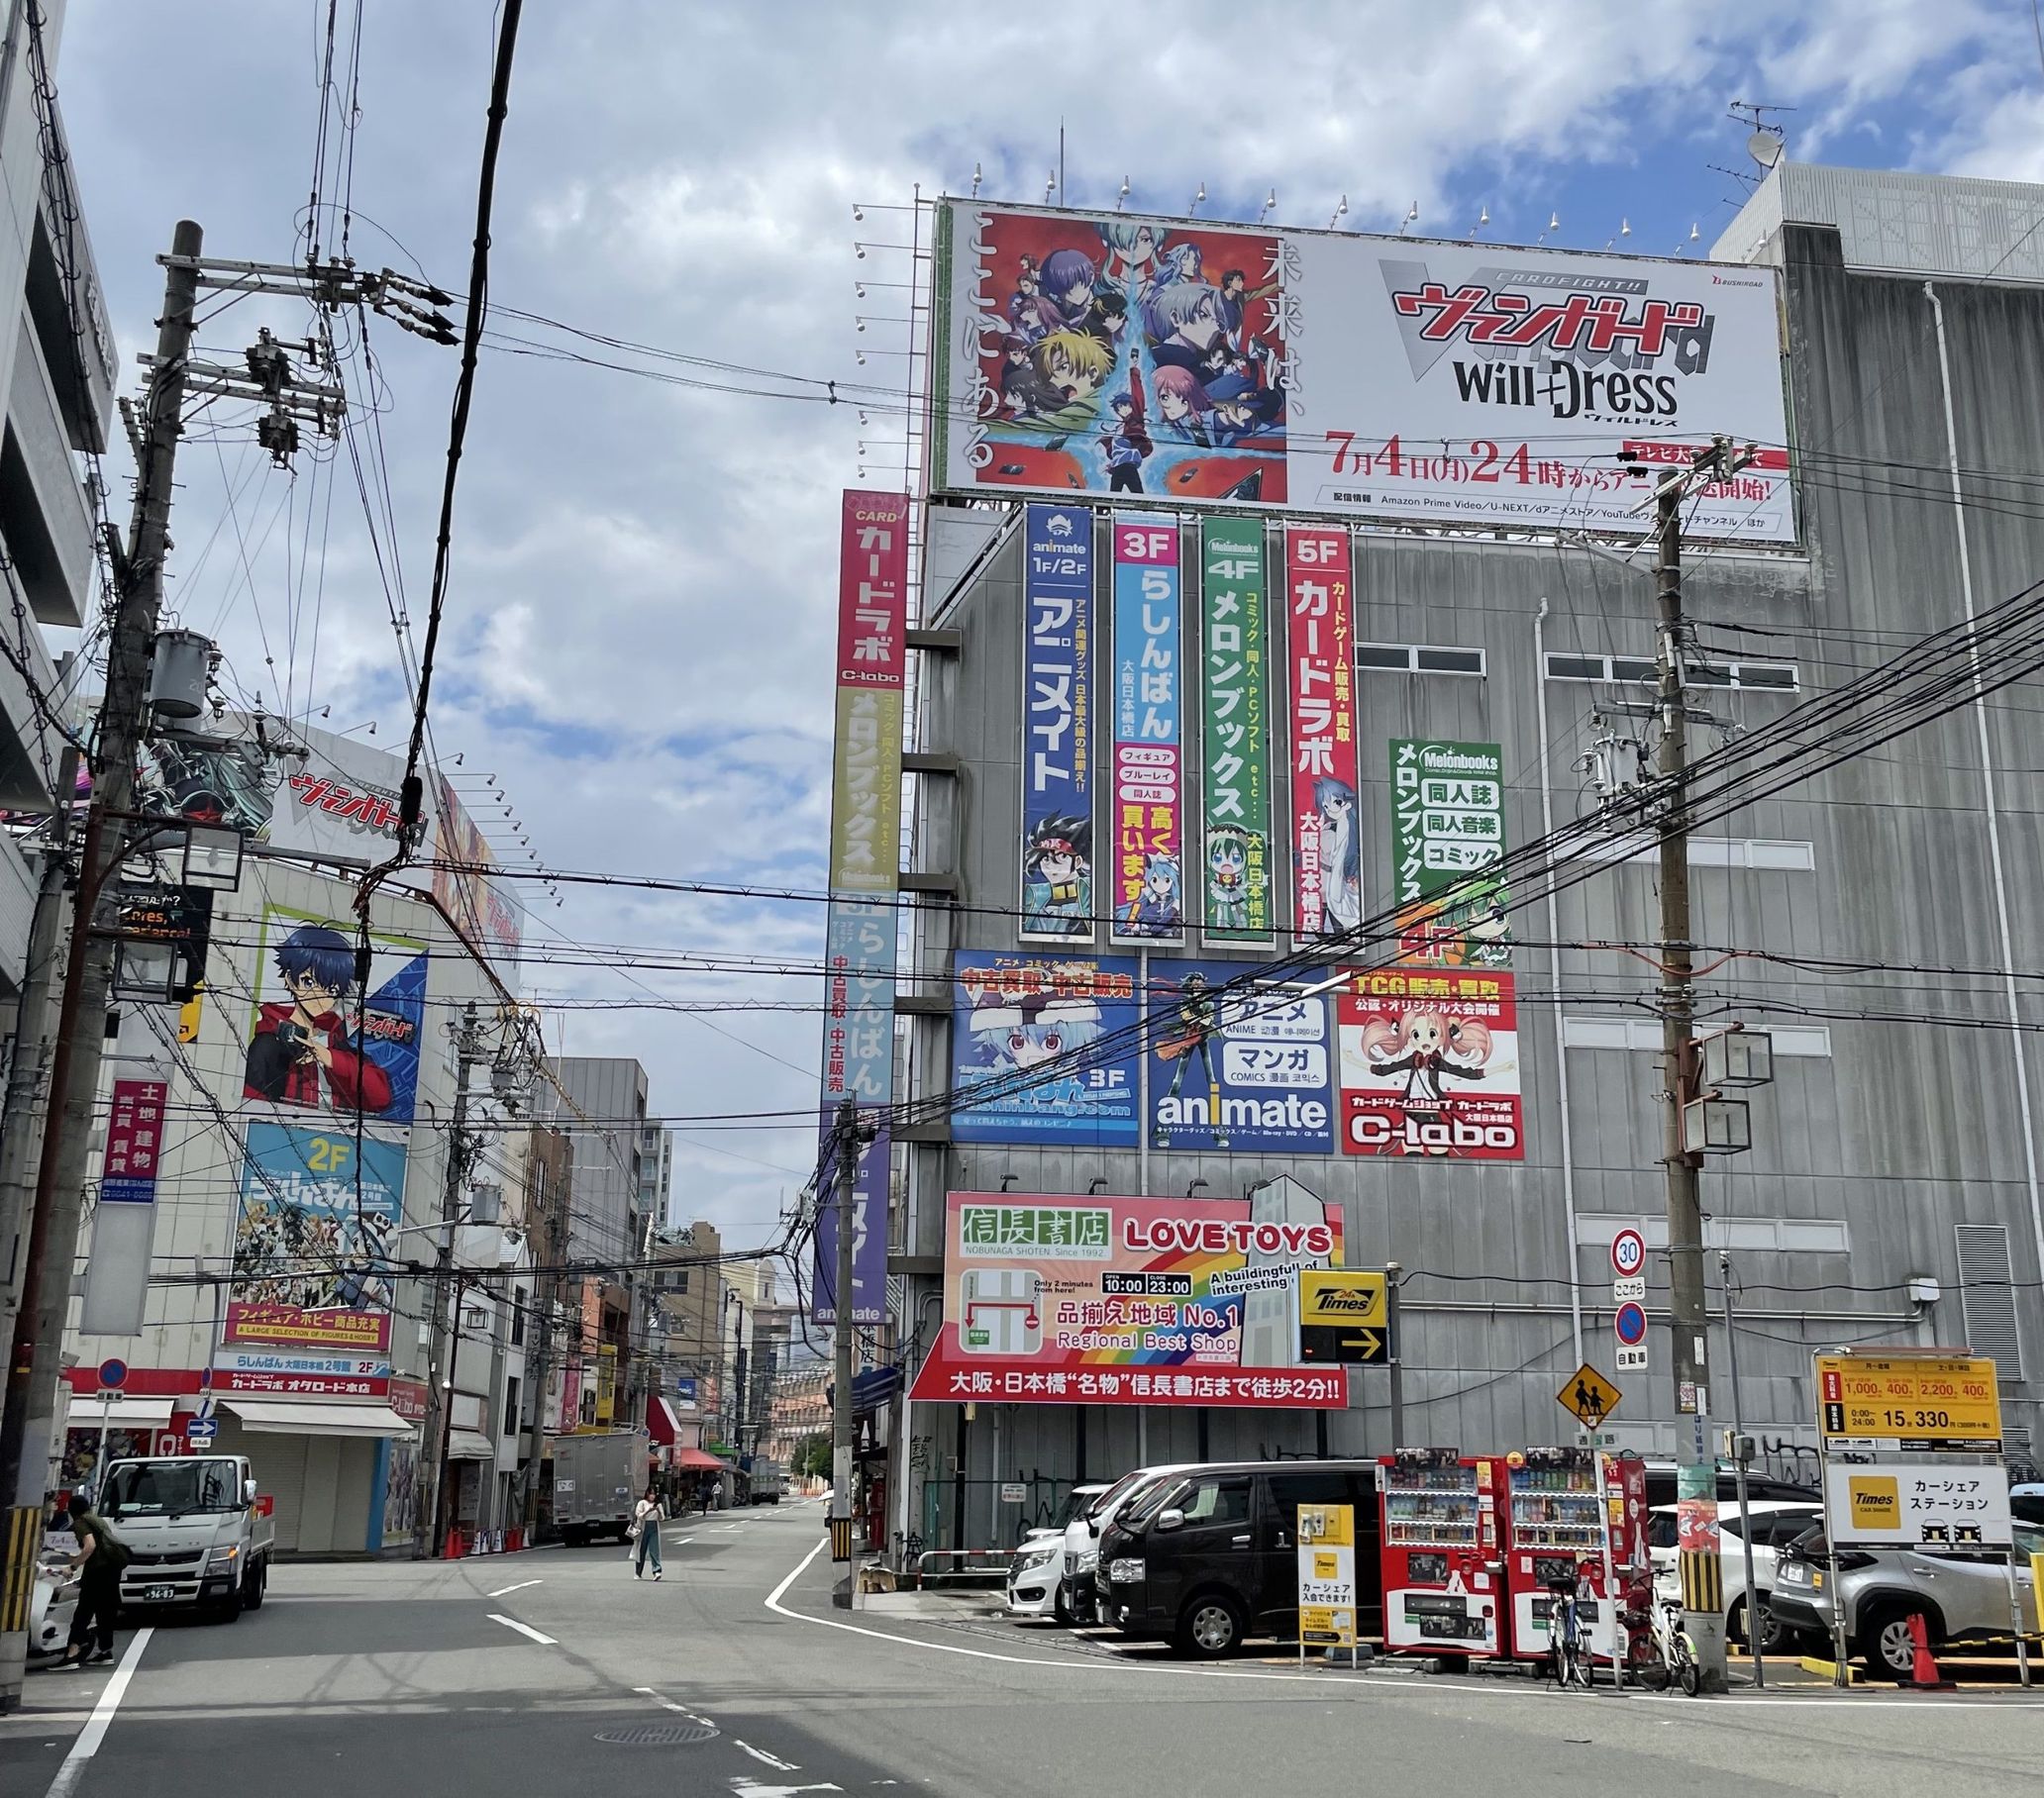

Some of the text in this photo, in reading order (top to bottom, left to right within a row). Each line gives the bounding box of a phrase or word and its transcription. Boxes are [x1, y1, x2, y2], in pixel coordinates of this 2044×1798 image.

[1495, 271, 1641, 291] CARDFIGHT!!
[1261, 239, 1305, 416] 未来は、
[1392, 282, 1704, 355] ヴァンガード
[962, 212, 1002, 469] ここにある
[1333, 492, 1372, 503] 配信情報
[1380, 496, 1420, 506] Amazon
[1424, 498, 1451, 508] Prime
[856, 510, 897, 523] CARD
[1033, 540, 1085, 554] animate
[1123, 532, 1169, 558] 3F
[1297, 540, 1338, 563] 5F
[1033, 557, 1085, 575] 1F/2F
[1208, 559, 1259, 579] 4F
[852, 526, 895, 661] カードラボ
[1140, 569, 1173, 739] らしんばん
[842, 669, 899, 683] C-labo
[1294, 580, 1334, 775] カードラボ
[1031, 597, 1073, 791] アニメイト
[1121, 660, 1135, 738] 大阪日本橋店
[1210, 590, 1246, 818] メロンブックス
[1124, 750, 1171, 761] フィギュア
[1424, 750, 1497, 770] Melonbooks
[842, 692, 879, 863] メロンブックス
[1124, 769, 1171, 780] ブルーレイ
[1133, 789, 1162, 800] 同人誌
[1427, 782, 1492, 805] 同人誌
[1396, 744, 1422, 904] メロンブックス
[1427, 815, 1496, 835] 同人音楽
[1429, 848, 1497, 865] コミック
[1299, 811, 1321, 934] 大阪日本橋店
[1247, 834, 1264, 933] 大阪日本橋店
[1398, 922, 1458, 958] 4F
[851, 921, 887, 1096] らしんばん
[1238, 1049, 1309, 1071] マンガ
[1089, 1069, 1125, 1088] 3F
[1230, 1072, 1266, 1082] COMICS
[1292, 1073, 1320, 1083] 코믹스
[1157, 1083, 1327, 1129] animate
[1352, 1095, 1513, 1113] カードゲームショップ カードラボ
[133, 1084, 158, 1168] 土地建物
[1351, 1115, 1517, 1149] C-labo
[308, 1138, 349, 1172] 2F
[964, 1209, 1107, 1246] 信長書店
[1125, 1220, 1332, 1254] LOVE TOYS
[1016, 1247, 1050, 1255] SHOTEN
[1056, 1248, 1077, 1256] Since
[1619, 1243, 1637, 1262] 30
[1105, 1279, 1142, 1292] 10:00
[1150, 1279, 1188, 1293] 23:00
[1210, 1274, 1220, 1284] A
[1212, 1278, 1287, 1295] interesting
[1315, 1289, 1370, 1310] Times
[1616, 1283, 1643, 1296] ここから
[238, 1309, 380, 1331] フィギュア・ホビー商品充実
[1057, 1302, 1237, 1328] 品揃え地域 No.1
[1058, 1333, 1236, 1351] Regional Best Shop
[238, 1355, 283, 1368] らしんばん
[358, 1361, 373, 1373] 2F
[1618, 1352, 1646, 1364] 自動車
[232, 1378, 370, 1394] カードラボ オタロード本店
[1852, 1418, 1876, 1427] 24:00
[1915, 1480, 1981, 1493] カーシェア
[1855, 1493, 1893, 1505] Times
[1910, 1497, 1989, 1510] ステーション
[1302, 1584, 1350, 1593] カーシェア
[1303, 1593, 1350, 1603] 入会できます!
